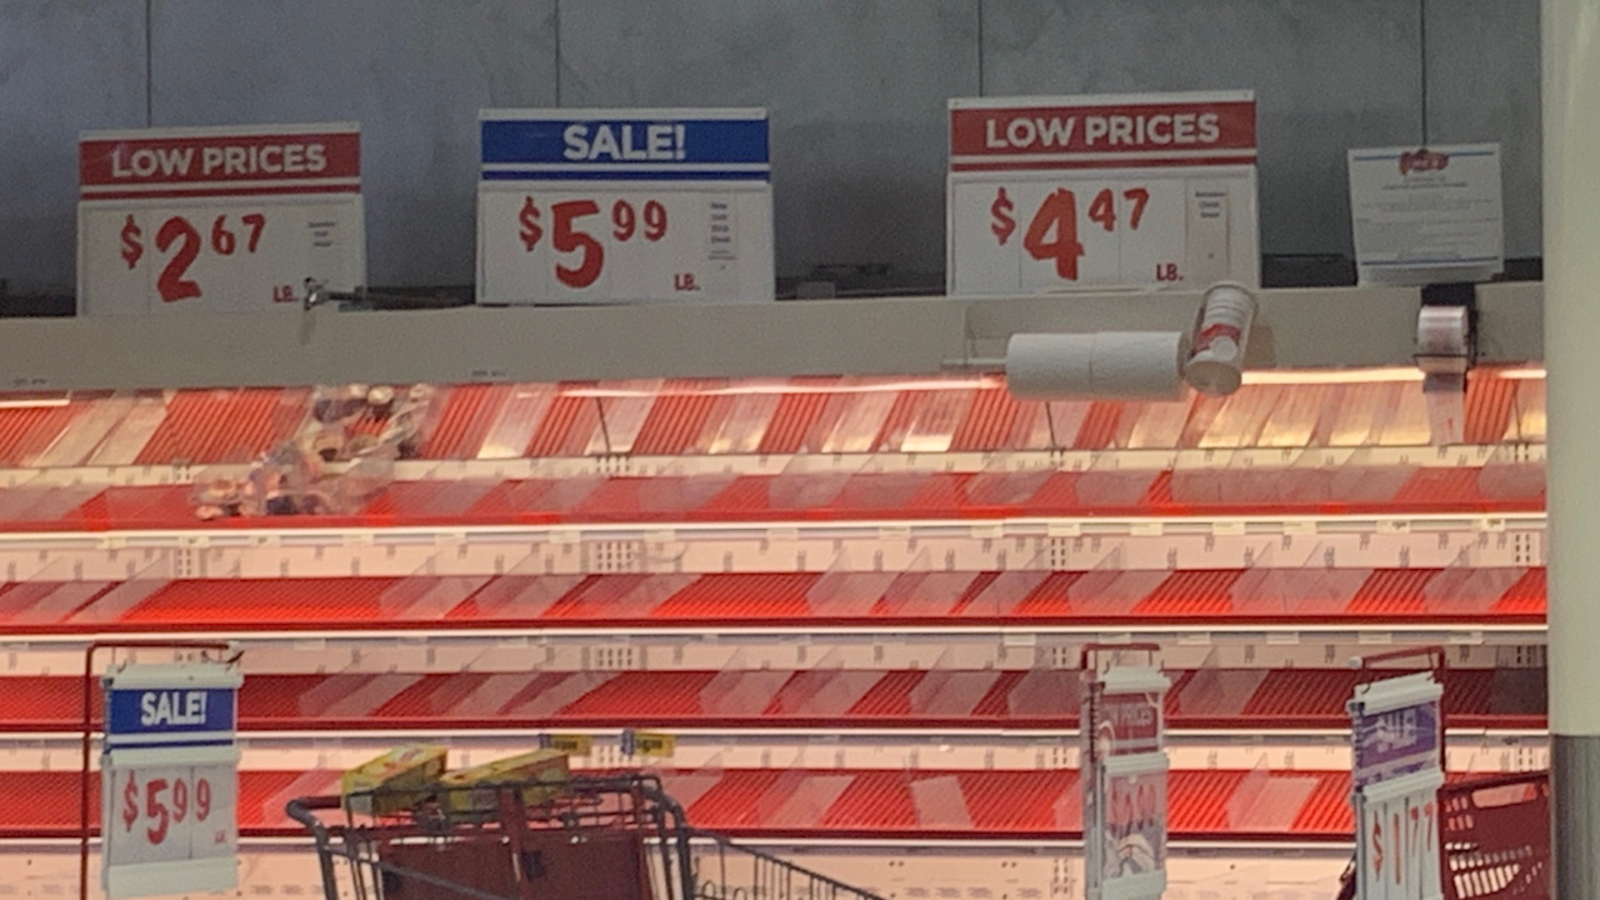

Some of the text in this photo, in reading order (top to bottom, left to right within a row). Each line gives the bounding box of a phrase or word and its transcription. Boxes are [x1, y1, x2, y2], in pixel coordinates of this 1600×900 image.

[563, 123, 686, 161] SALE!
[986, 112, 1221, 149] LOW PRICES
[111, 143, 327, 178] LOW PRICES
[674, 273, 701, 292] LB.
[1156, 263, 1185, 282] LB.
[141, 691, 208, 725] SALE!
